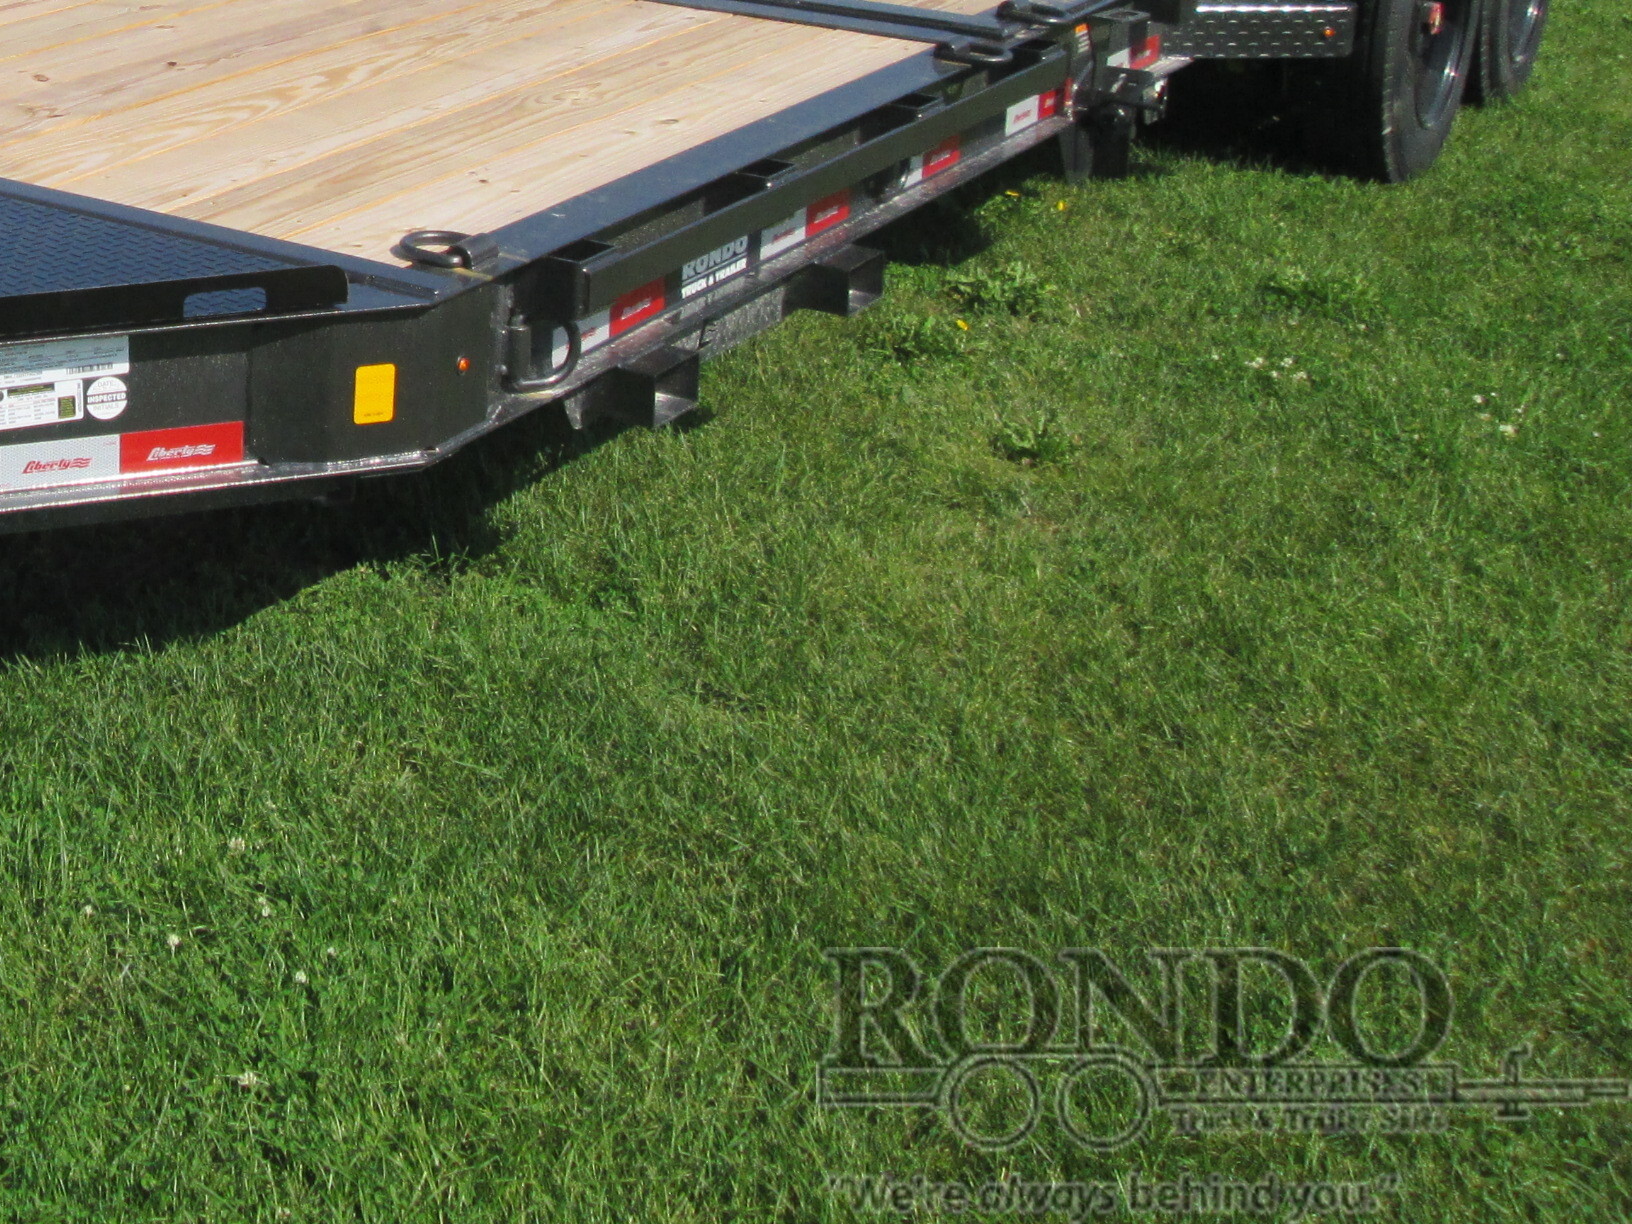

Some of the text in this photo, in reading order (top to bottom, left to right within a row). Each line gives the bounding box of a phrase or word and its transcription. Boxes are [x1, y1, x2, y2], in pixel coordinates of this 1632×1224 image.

[681, 235, 749, 280] RONDO
[86, 391, 127, 404] INSPECTED
[145, 444, 196, 462] Liberty
[21, 457, 72, 475] Liberty
